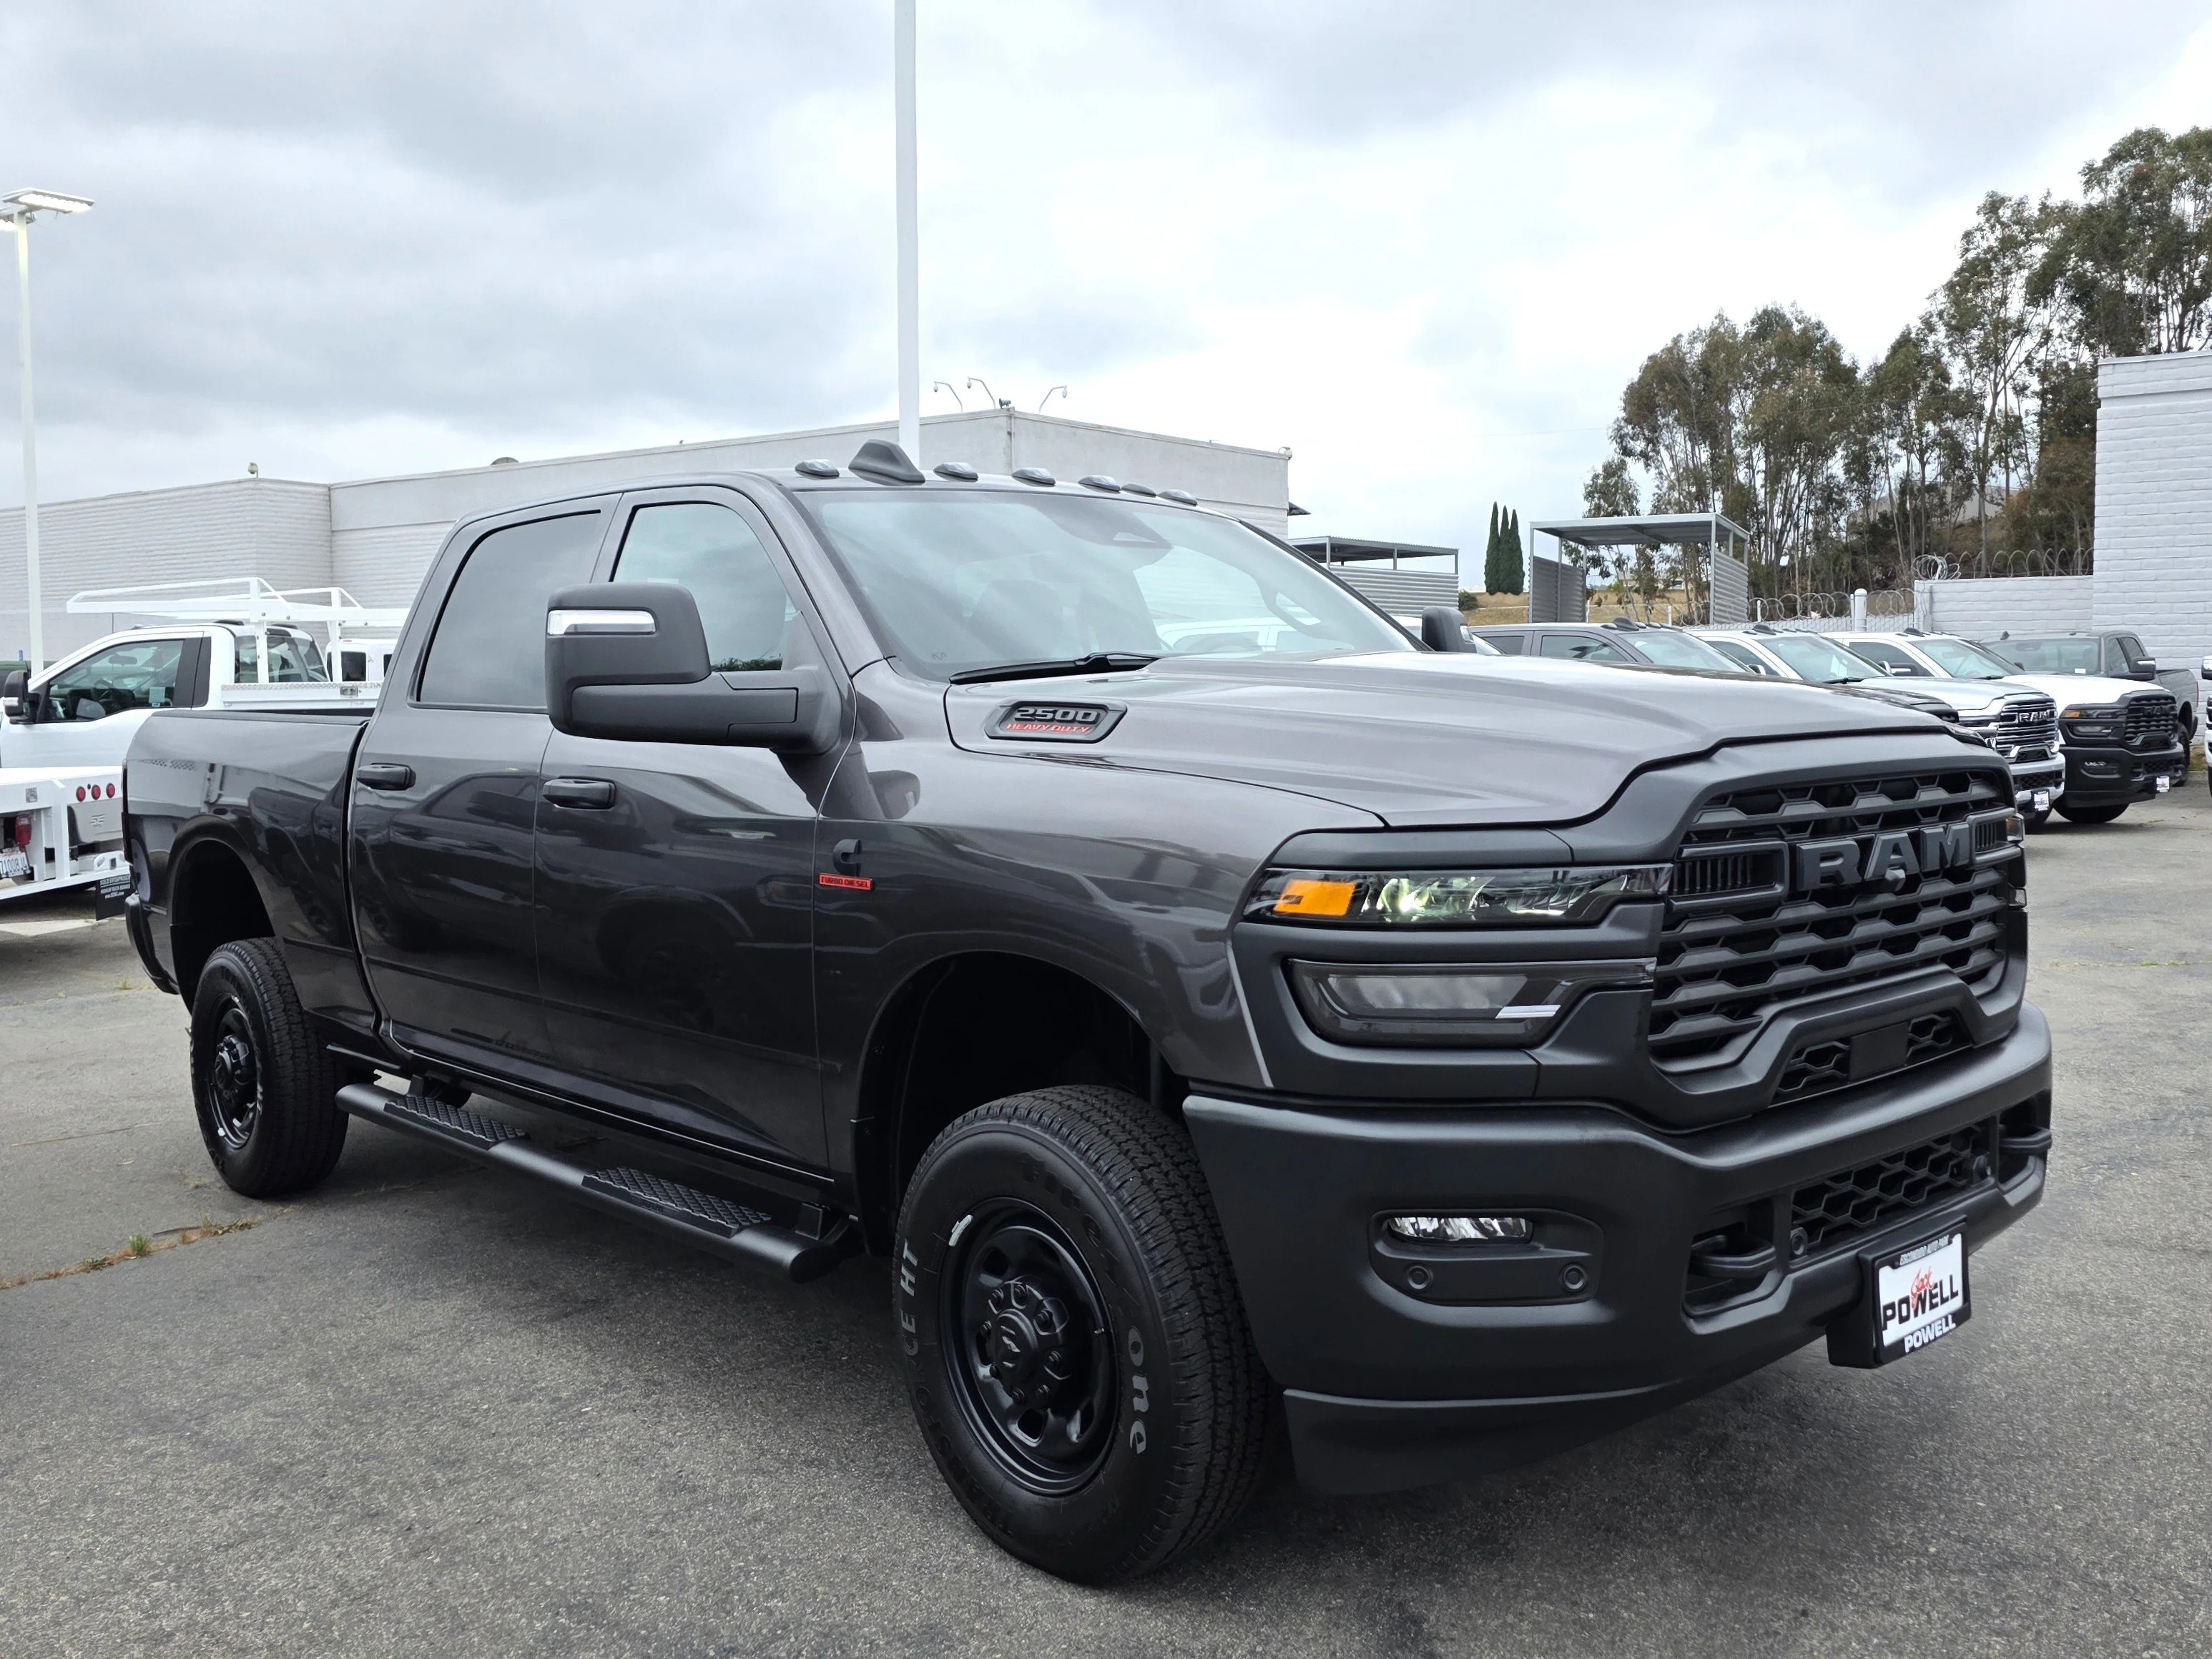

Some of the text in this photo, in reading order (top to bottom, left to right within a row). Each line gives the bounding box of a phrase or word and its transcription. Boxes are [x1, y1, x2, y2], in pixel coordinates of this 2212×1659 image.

[1006, 723, 1050, 732] HEAVY
[1014, 707, 1101, 724] 2500
[2019, 708, 2050, 722] RAM
[1796, 823, 1970, 891] RAM
[821, 876, 869, 887] TURBO DIESEL
[900, 1239, 918, 1297] HT
[1882, 1274, 1959, 1331] POWELL
[1904, 1314, 1957, 1354] POWELL
